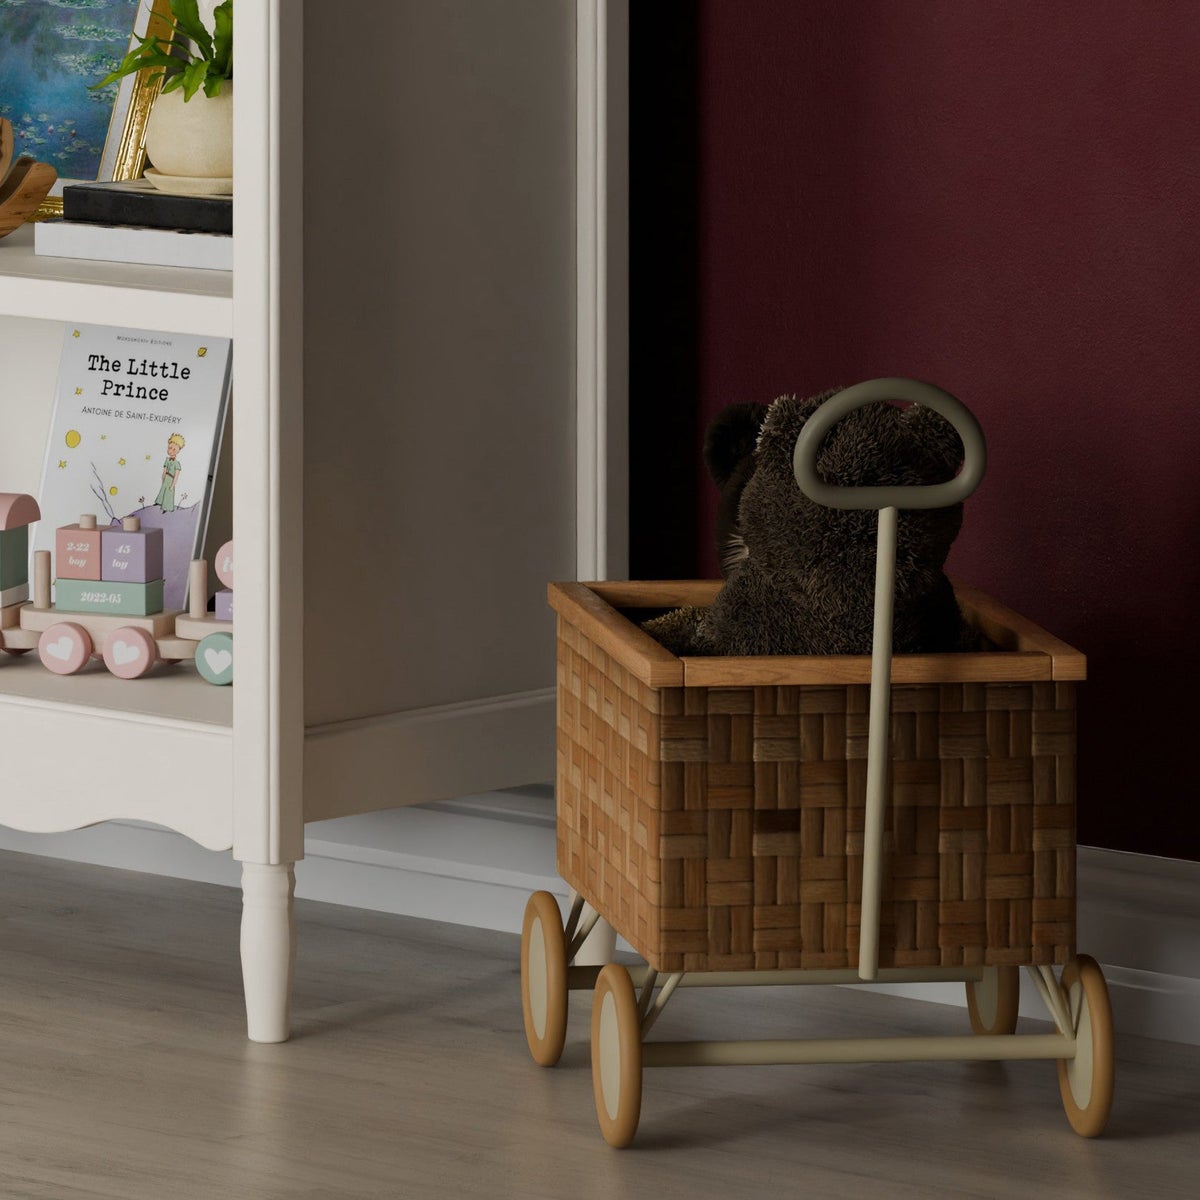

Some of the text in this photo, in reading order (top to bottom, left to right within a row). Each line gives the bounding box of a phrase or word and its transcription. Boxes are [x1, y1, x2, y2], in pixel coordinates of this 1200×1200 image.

[88, 354, 191, 380] The Little
[100, 379, 169, 401] Prince
[80, 591, 122, 604] 2022-05
